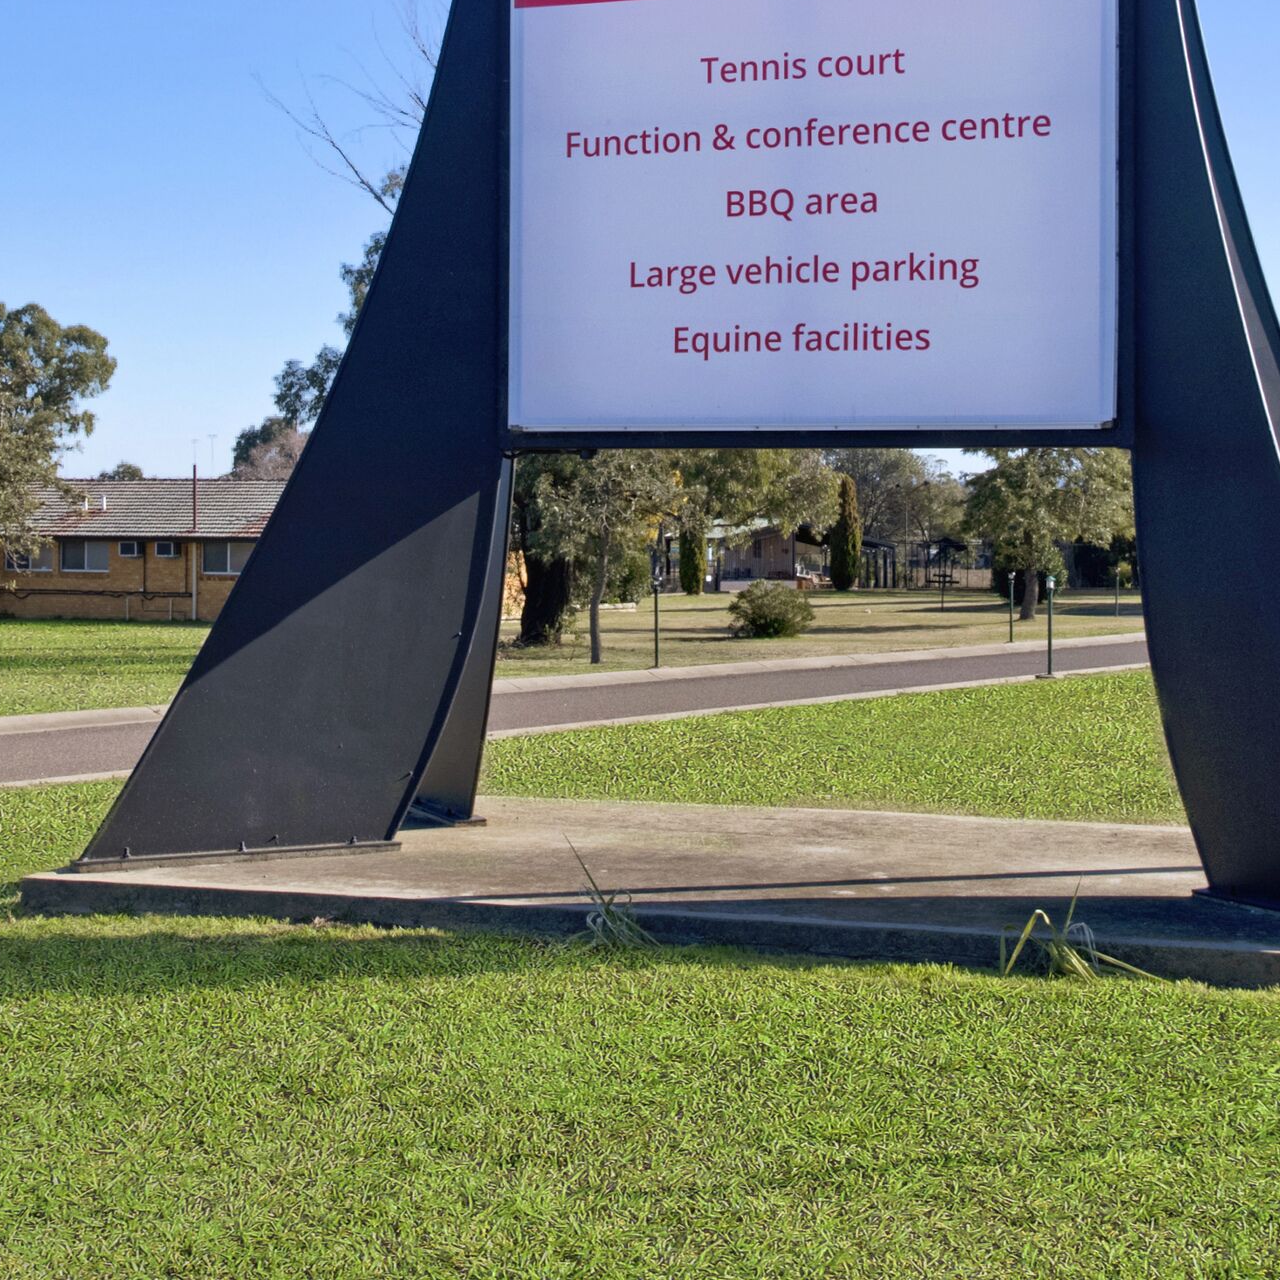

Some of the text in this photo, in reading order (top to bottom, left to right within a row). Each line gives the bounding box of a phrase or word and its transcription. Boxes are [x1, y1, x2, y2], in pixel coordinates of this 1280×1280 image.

[700, 48, 906, 84] Tennis court
[566, 112, 1052, 159] Function & conference centre
[726, 188, 878, 222] BBQ area
[630, 252, 980, 295] Large vehicle parking
[674, 322, 931, 361] Equine facilities
